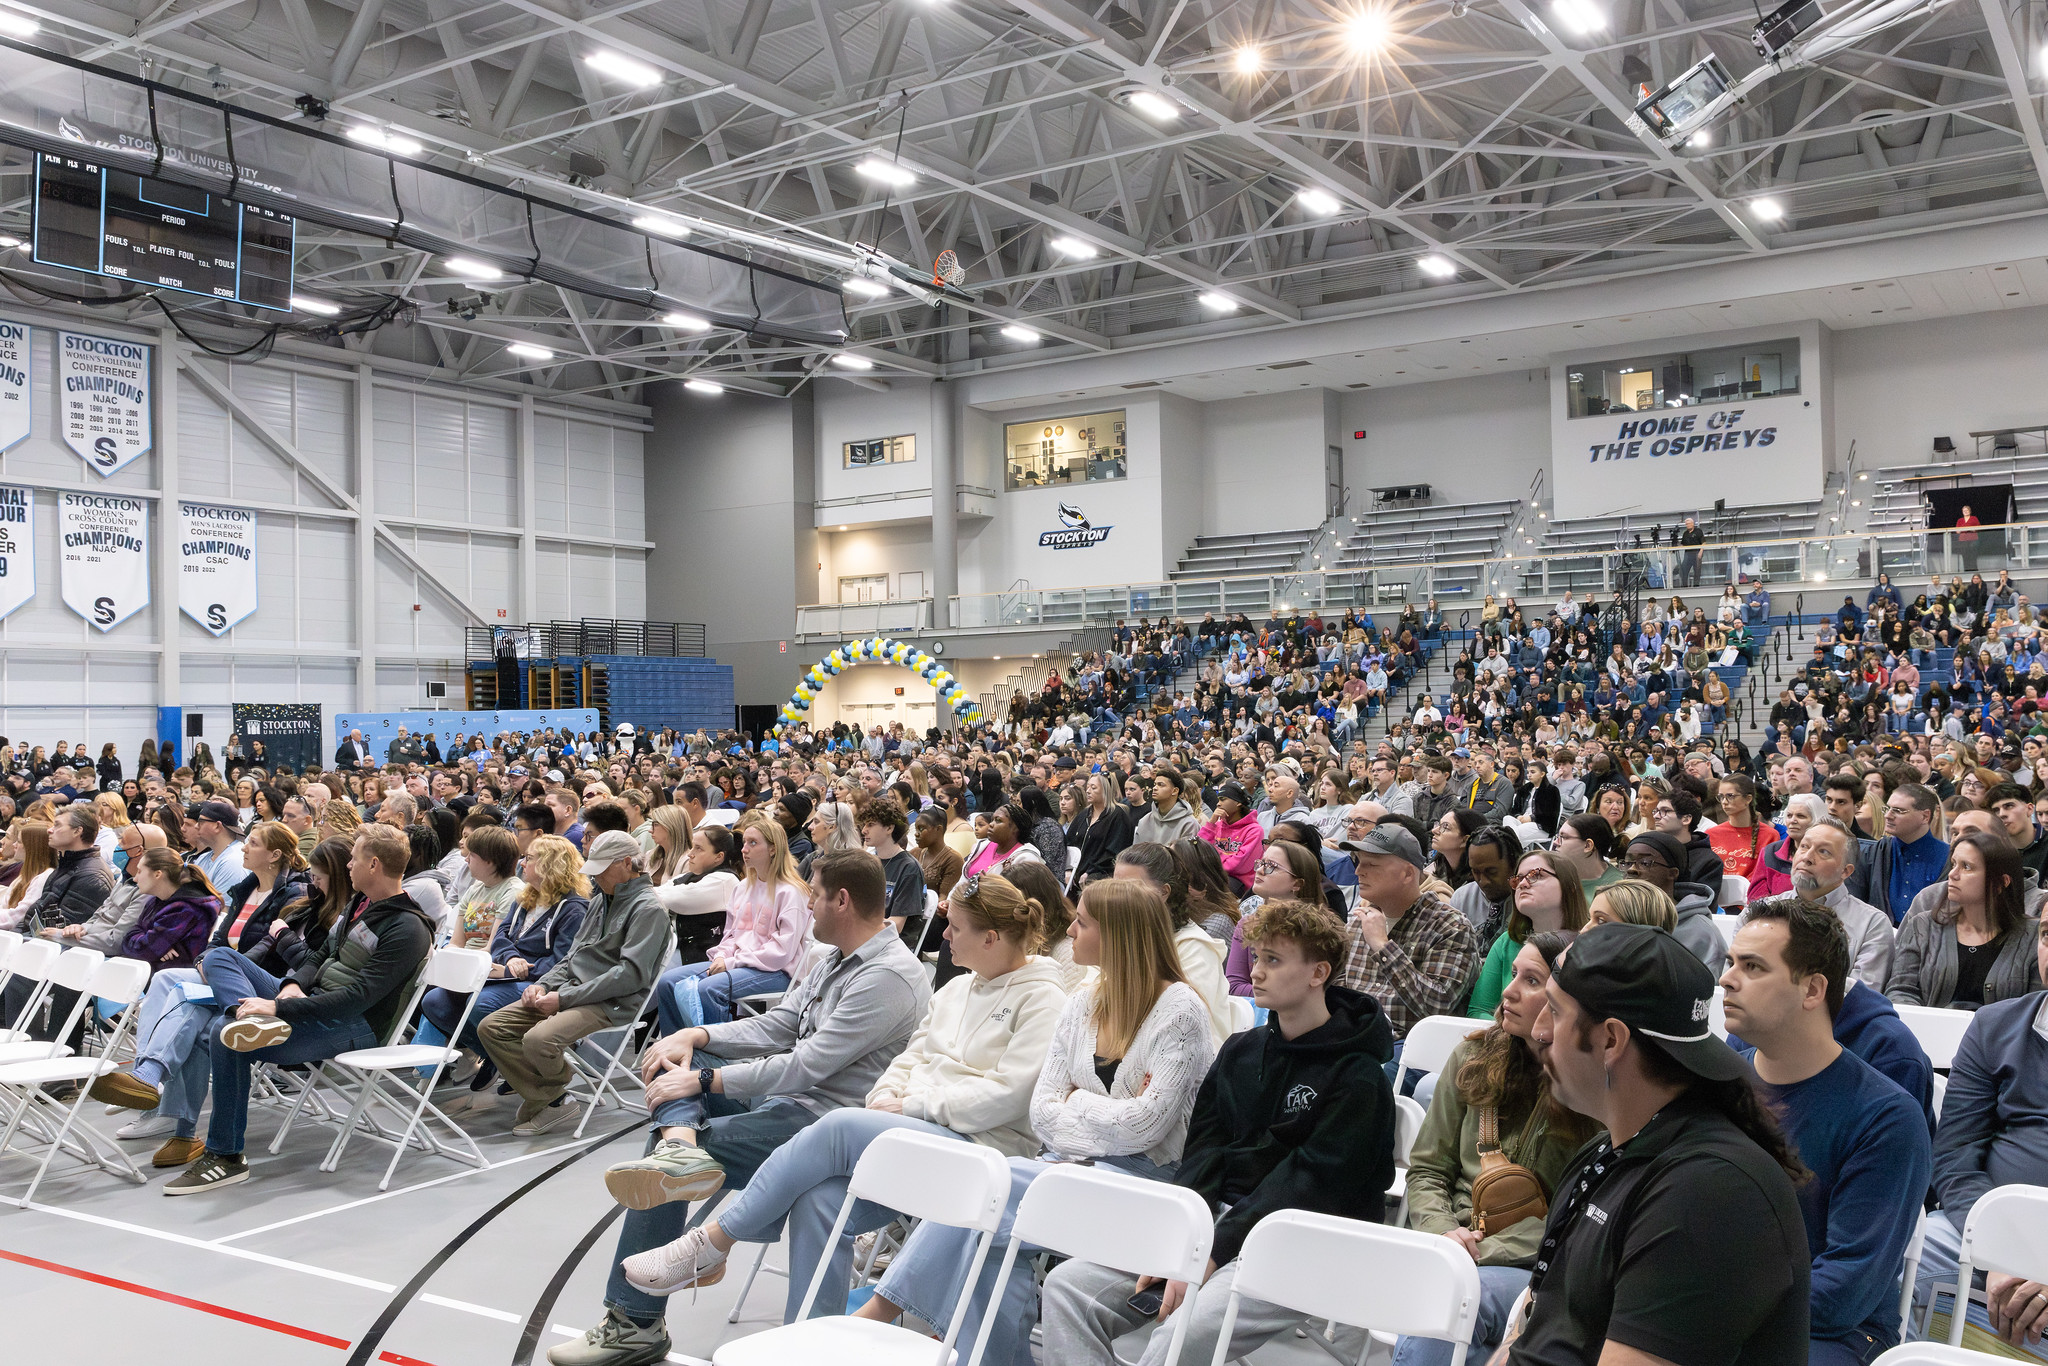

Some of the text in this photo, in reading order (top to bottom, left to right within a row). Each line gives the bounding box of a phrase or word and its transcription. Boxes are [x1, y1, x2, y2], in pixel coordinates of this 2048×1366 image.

[162, 214, 186, 226] PERIOD
[105, 234, 128, 247] FOULS
[149, 244, 195, 261] PLAYER FOUL
[214, 258, 235, 269] FOULS
[104, 265, 128, 277] SCORE
[159, 276, 183, 288] MATCH
[213, 287, 234, 298] SCORE
[65, 335, 142, 361] STOCKTON
[72, 361, 138, 379] CONFERENCE
[66, 375, 144, 404] CHAMPIONS
[93, 394, 118, 405] NJAC
[1617, 410, 1744, 441] HOME OF
[1588, 427, 1778, 464] THE OSPREYS
[65, 494, 142, 512] STOCKTON
[68, 513, 139, 526] CROSS COUNTRY
[83, 508, 125, 519] WOMEN'S
[183, 505, 251, 522] STOCKTON
[79, 522, 129, 533] CONFERENCE
[190, 520, 243, 531] MEN'S LACROSSE
[190, 528, 243, 539] CONFERENCE
[1042, 529, 1106, 545] STOCKTON
[64, 531, 142, 553] CHAMPIONS
[92, 544, 117, 554] NJAC
[182, 540, 251, 561] CHAMPIONS
[205, 556, 229, 565] CSAC
[262, 720, 311, 730] STOCKTON
